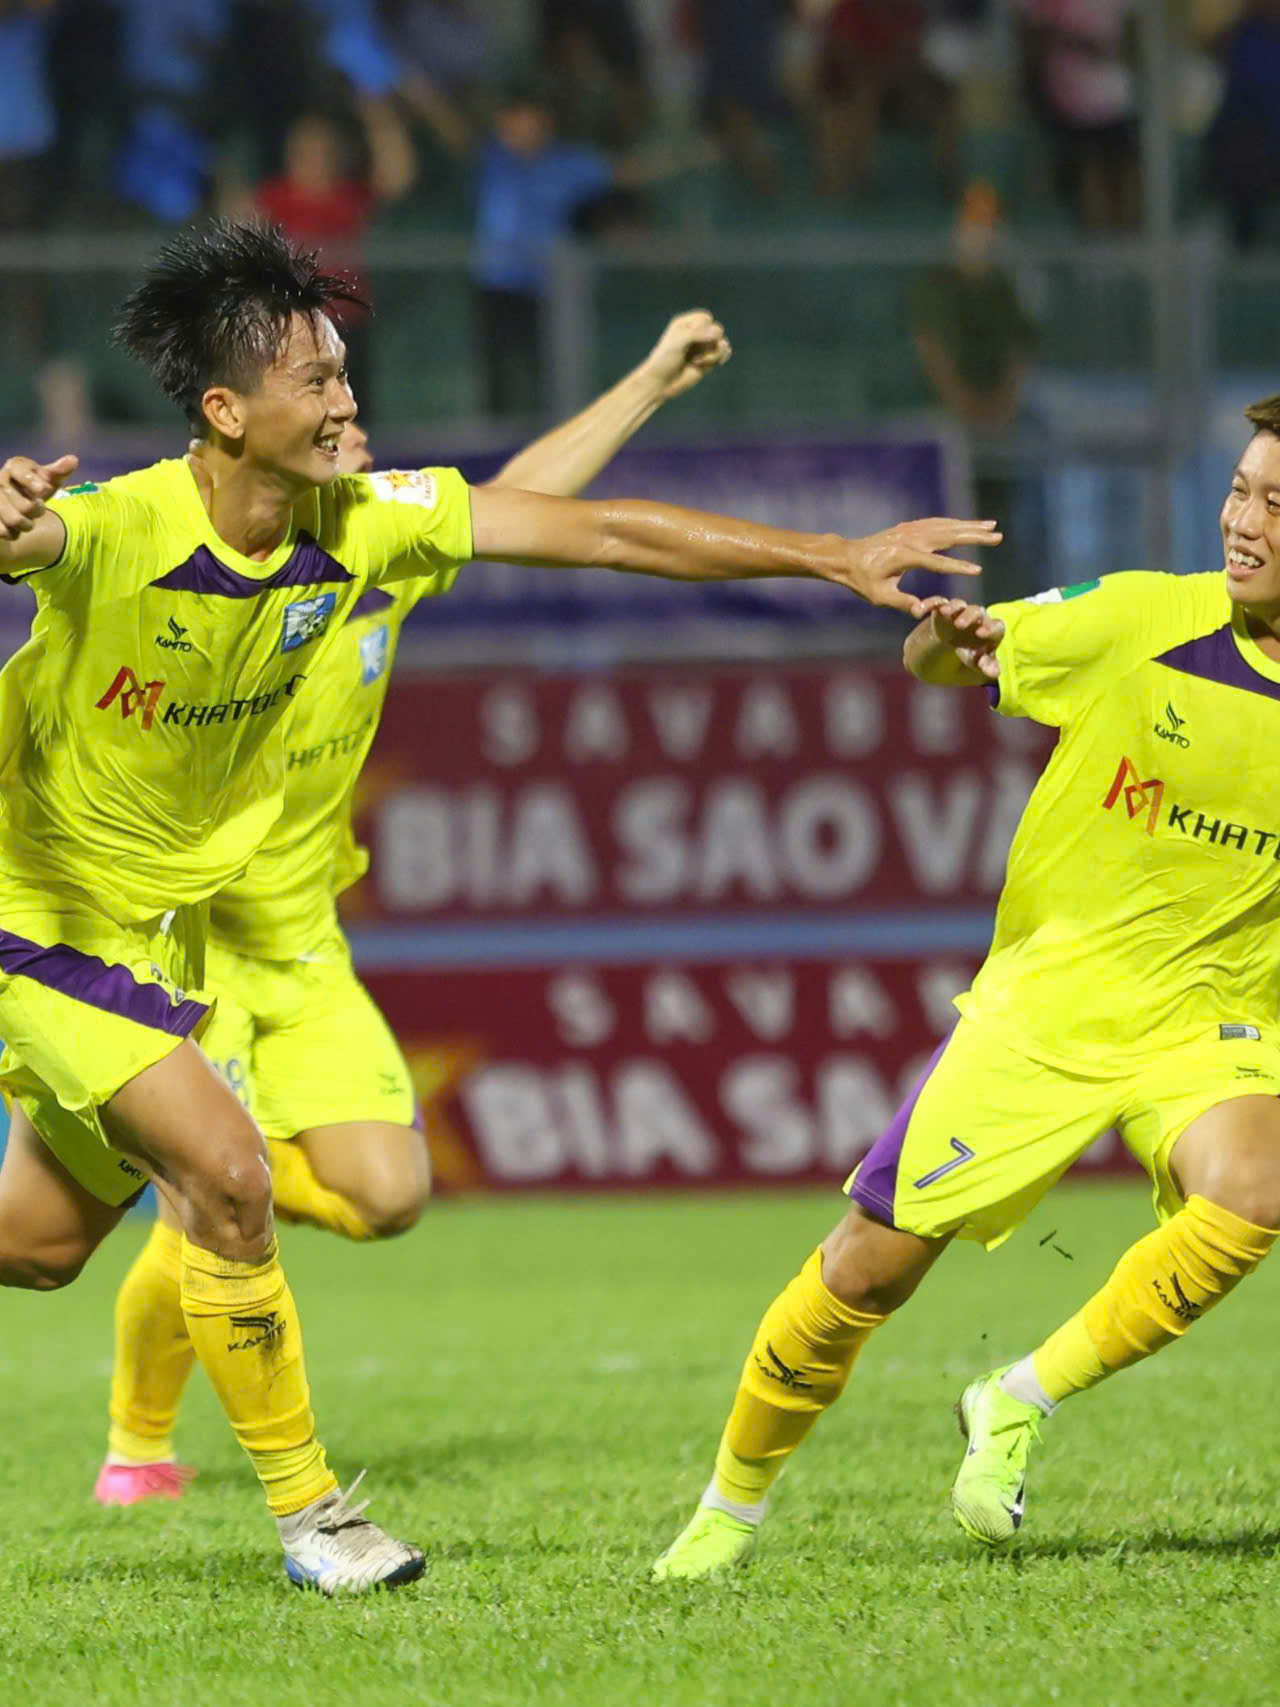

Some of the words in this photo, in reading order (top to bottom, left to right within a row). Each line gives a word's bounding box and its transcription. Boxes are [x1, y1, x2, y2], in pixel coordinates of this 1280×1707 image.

[1153, 723, 1191, 749] KAMITO
[380, 785, 596, 910] BIA
[613, 776, 884, 904] SAO
[1168, 804, 1279, 861] KHAT
[460, 1059, 715, 1180] BIA
[722, 1053, 928, 1176] SA
[913, 1136, 976, 1190] 7
